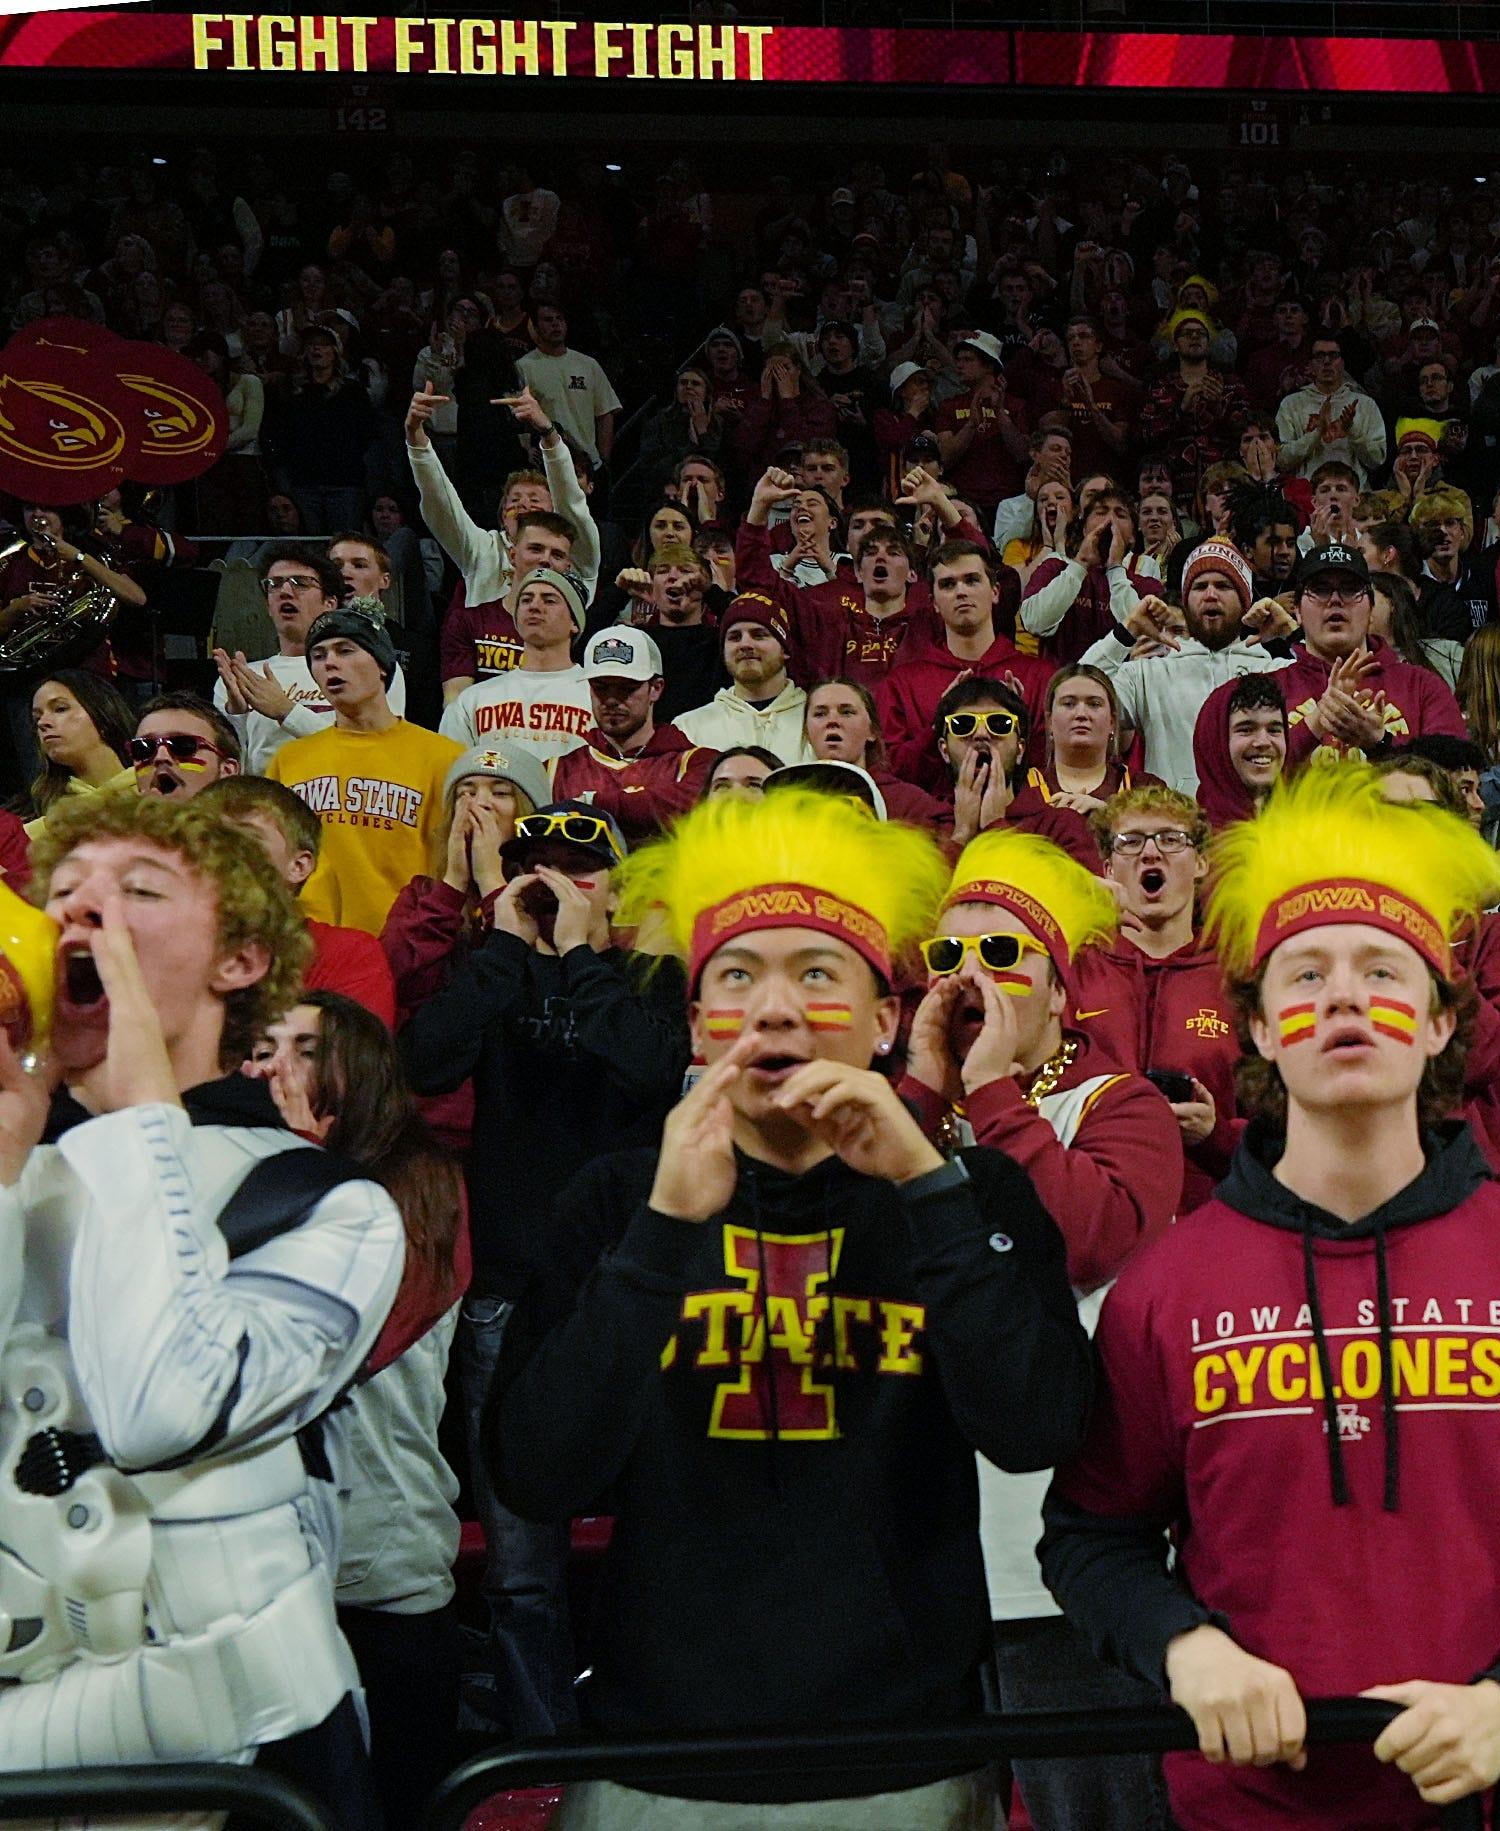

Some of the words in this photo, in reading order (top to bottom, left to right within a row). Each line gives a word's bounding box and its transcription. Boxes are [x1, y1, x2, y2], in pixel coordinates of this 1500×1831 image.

[193, 14, 378, 73] FIGHT
[395, 18, 577, 77] FIGHT
[593, 23, 773, 80] FIGHT
[335, 107, 388, 131] 142
[1239, 122, 1280, 144] 101
[1319, 551, 1353, 561] STATE
[484, 633, 517, 644] IOWA
[477, 643, 525, 672] CYCL
[476, 702, 525, 736] IOWA
[529, 702, 592, 736] STATE
[295, 776, 342, 813] OWA
[346, 776, 422, 828] STATE
[712, 890, 813, 935] IOWA
[1276, 887, 1376, 928] IOWA
[1186, 1015, 1230, 1035] STATE
[660, 1288, 926, 1376] TATE
[1192, 1301, 1314, 1345] IOWA
